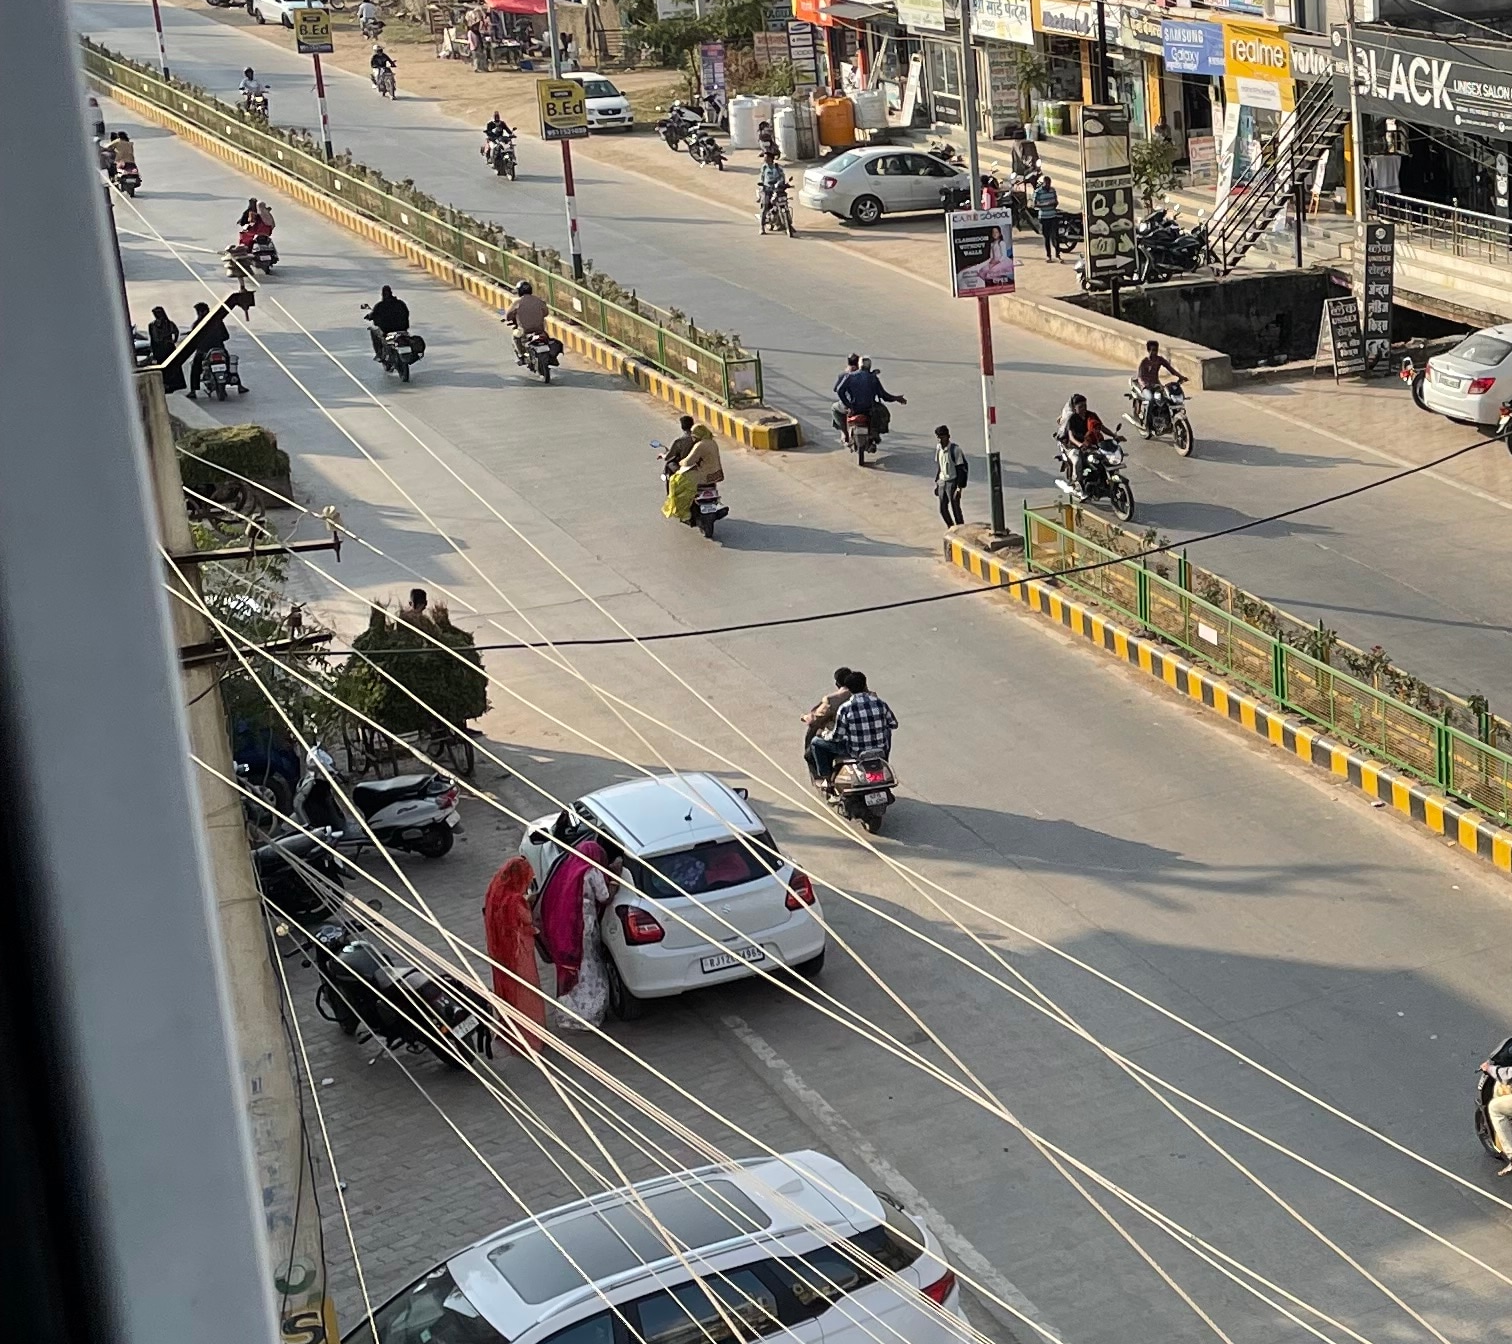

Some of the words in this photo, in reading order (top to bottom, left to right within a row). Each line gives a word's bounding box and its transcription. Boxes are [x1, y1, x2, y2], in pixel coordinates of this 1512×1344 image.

[1164, 27, 1204, 44] SAMSUNG
[1170, 47, 1200, 65] Galaxy
[1230, 37, 1286, 69] realme
[1352, 46, 1455, 110] BLACK
[1453, 80, 1483, 98] UNISEX
[1483, 83, 1510, 100] SALON
[546, 100, 583, 116] B.Ed
